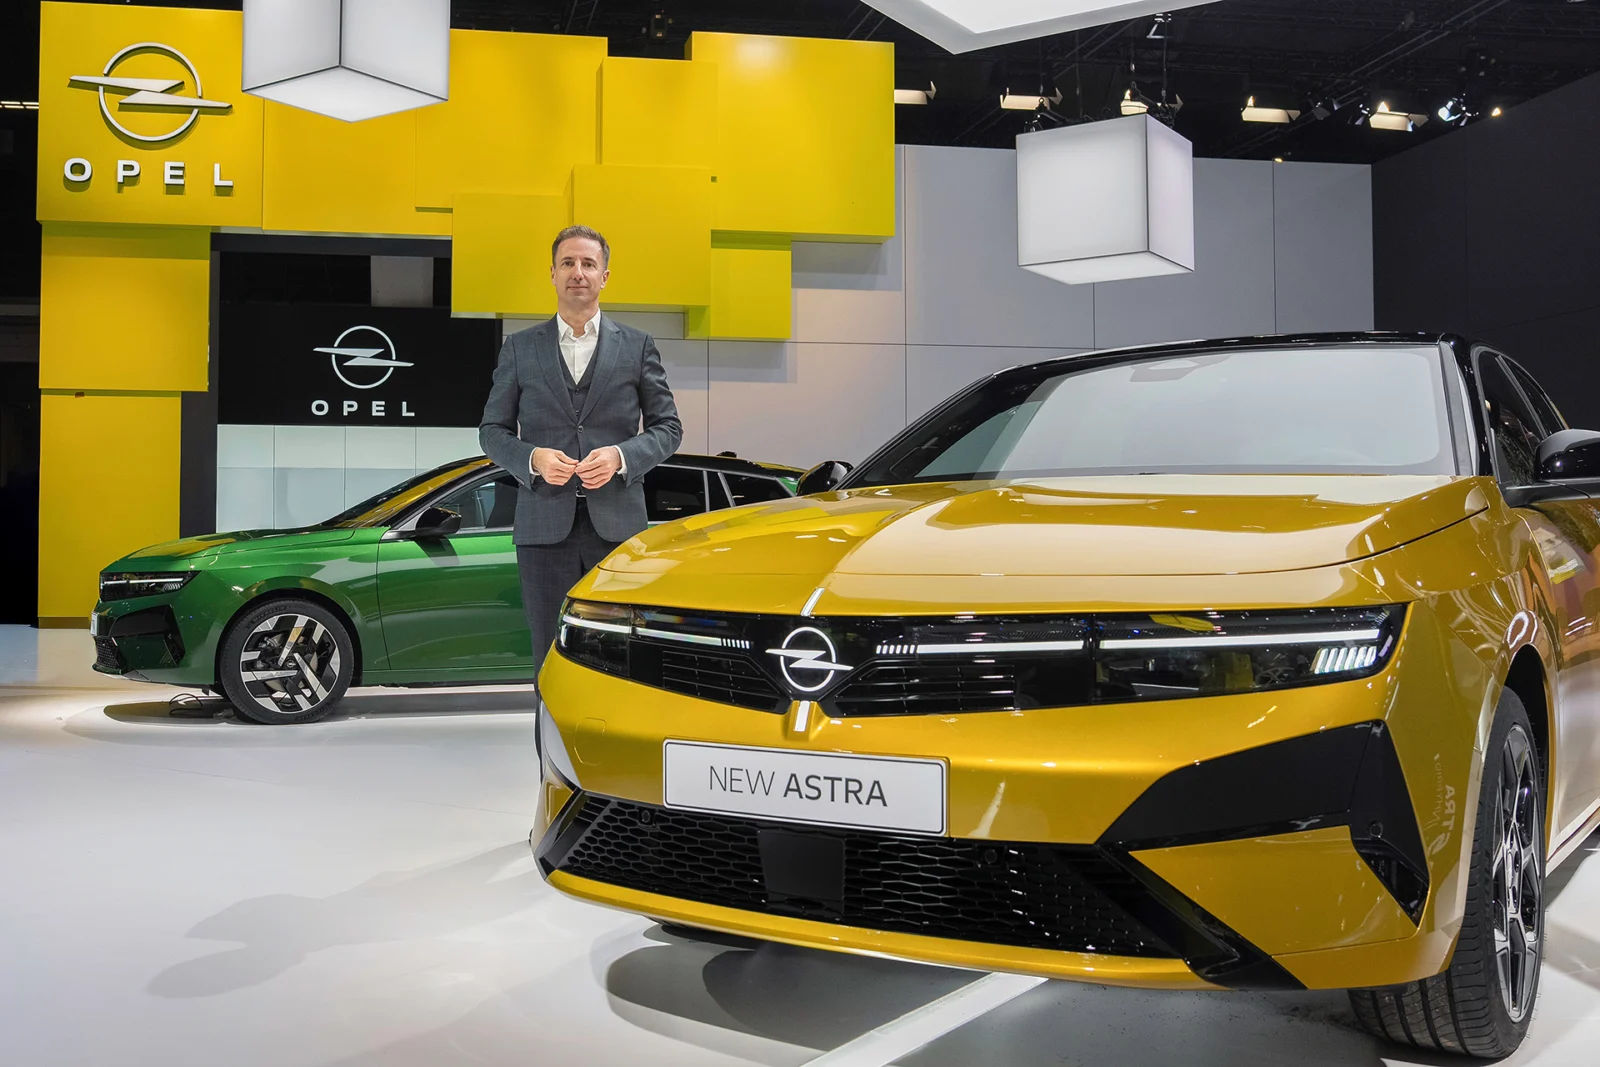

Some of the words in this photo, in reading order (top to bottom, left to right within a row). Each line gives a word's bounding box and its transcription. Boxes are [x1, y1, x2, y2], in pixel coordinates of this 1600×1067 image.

[63, 157, 234, 187] OPEL
[310, 399, 416, 417] OPEL
[709, 765, 776, 797] NEW
[783, 773, 888, 807] ASTRA
